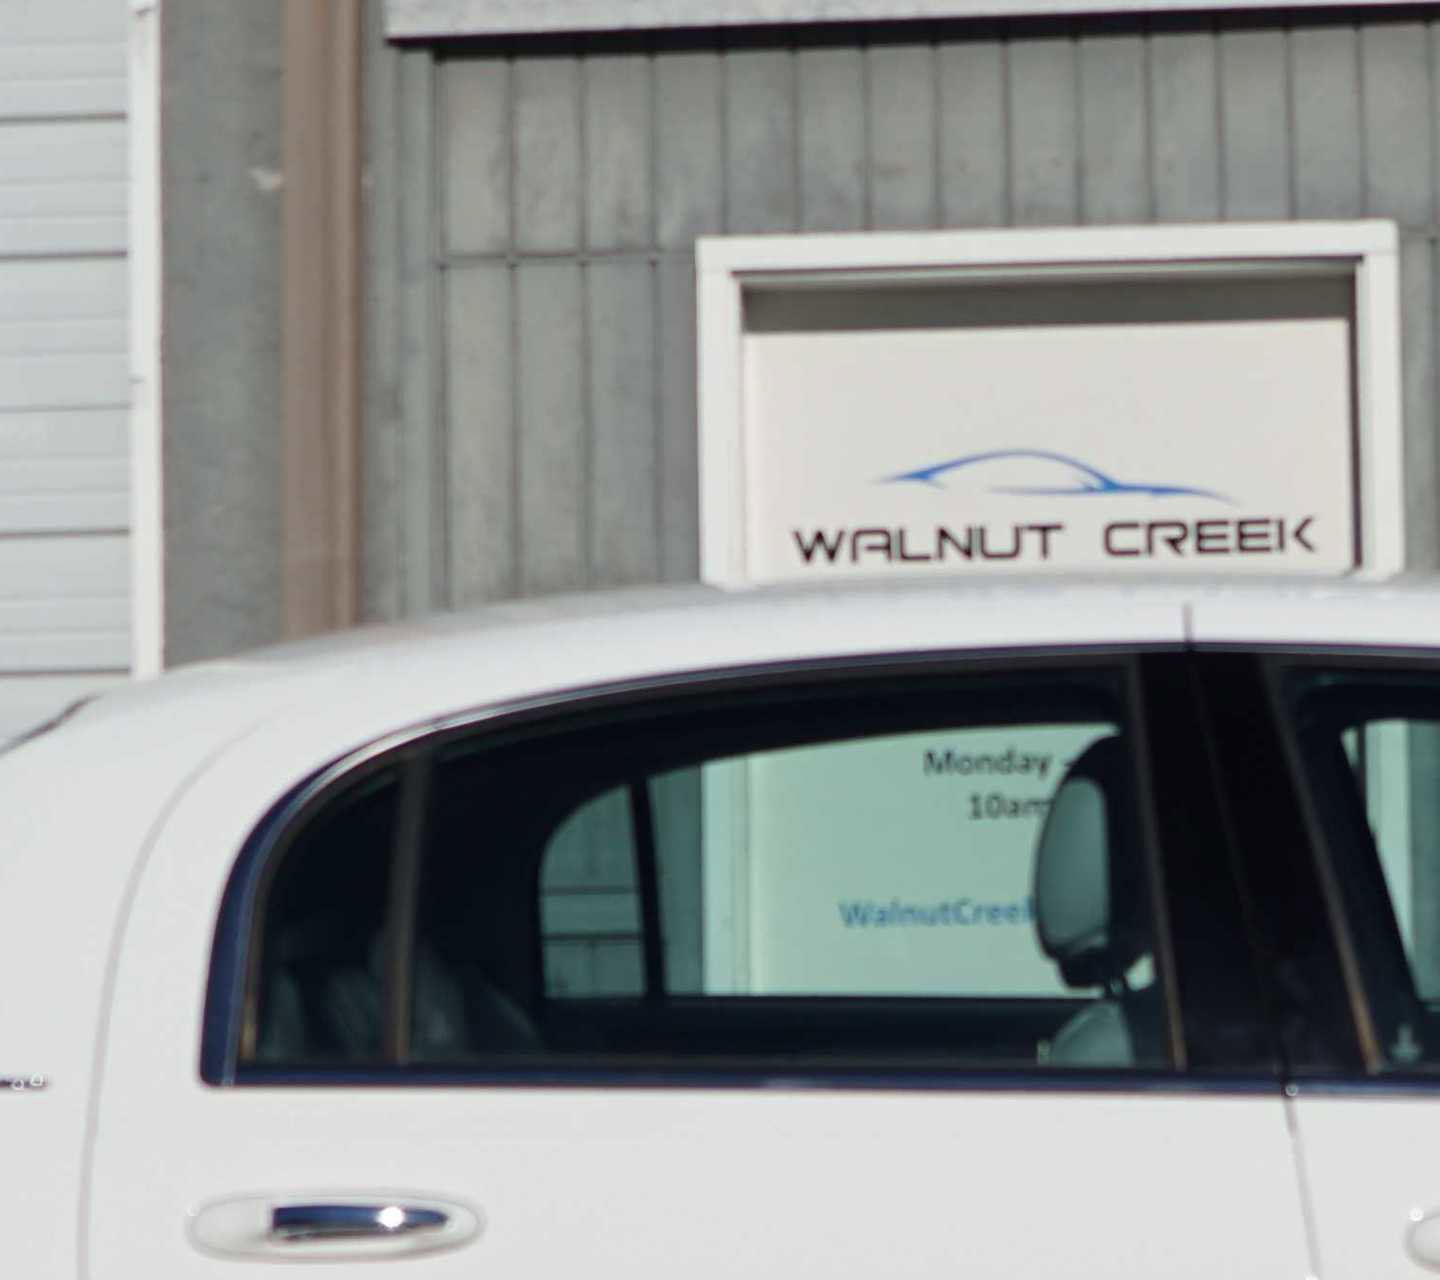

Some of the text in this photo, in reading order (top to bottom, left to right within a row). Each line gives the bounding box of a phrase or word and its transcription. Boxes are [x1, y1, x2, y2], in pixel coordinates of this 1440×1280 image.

[793, 517, 1317, 563] WALNUT CREEK
[923, 748, 1054, 779] Monday
